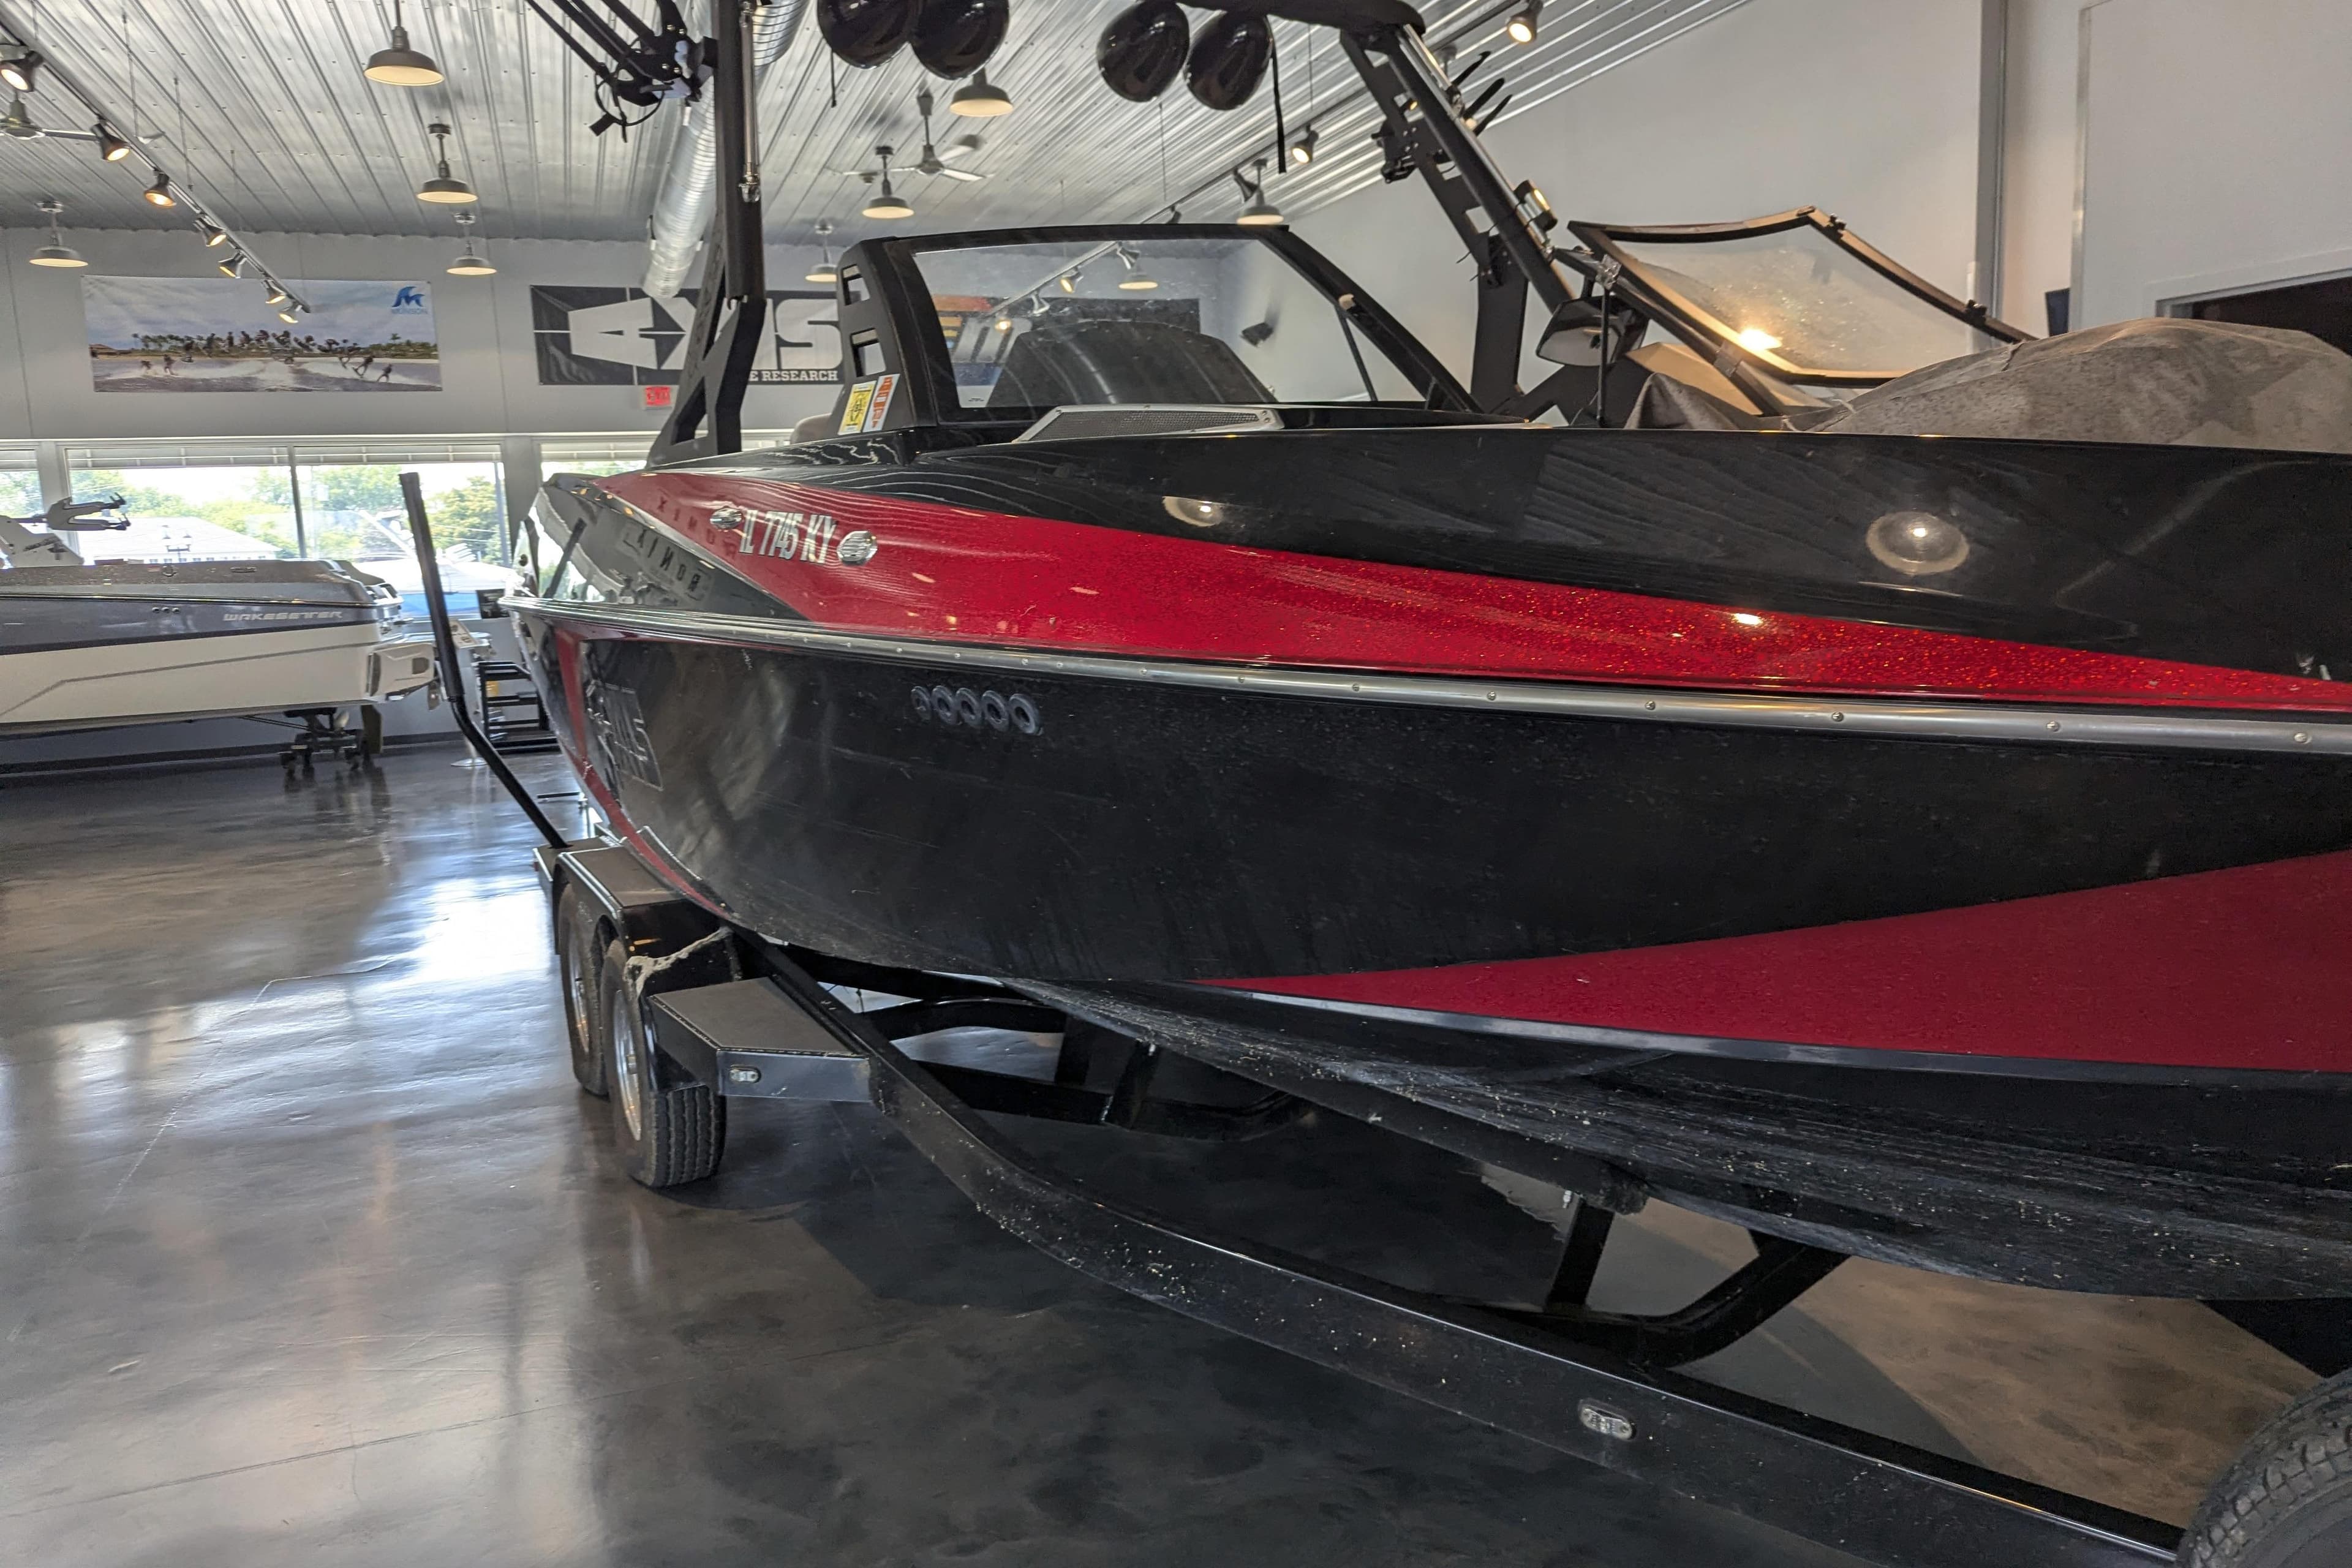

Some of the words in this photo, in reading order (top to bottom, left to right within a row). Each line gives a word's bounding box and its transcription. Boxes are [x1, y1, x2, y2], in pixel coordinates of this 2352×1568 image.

[762, 371, 838, 381] RESEARCH
[800, 514, 839, 564] KY
[223, 611, 343, 621] WAKESETTER
